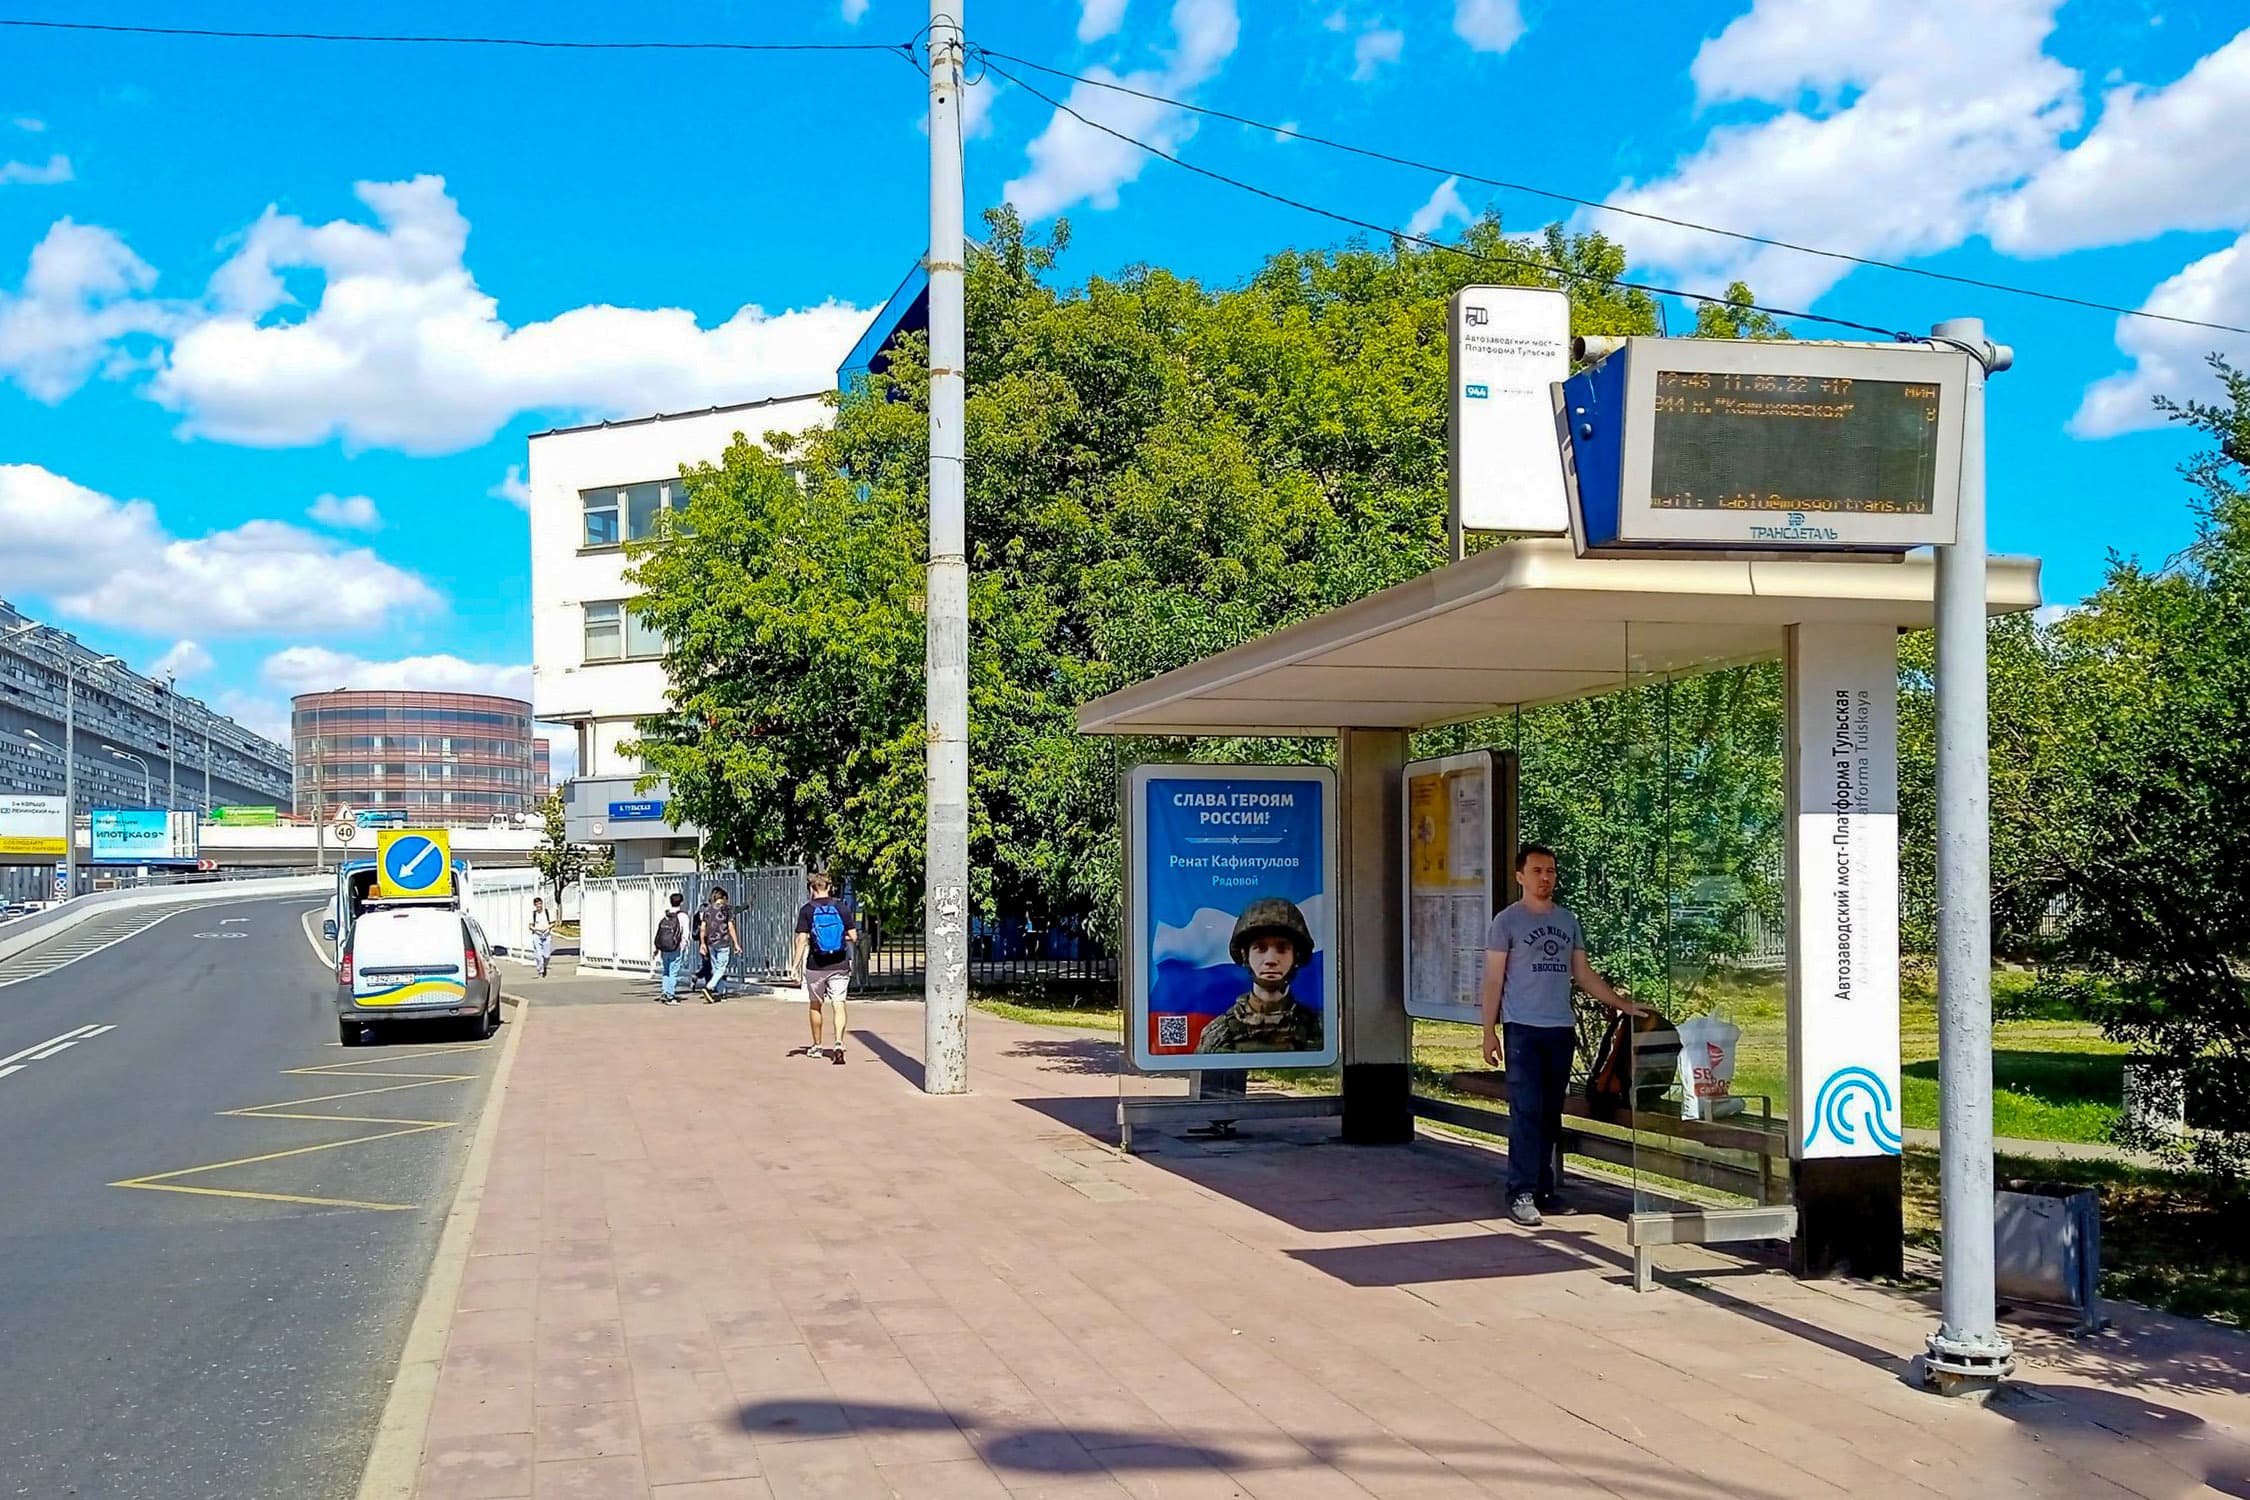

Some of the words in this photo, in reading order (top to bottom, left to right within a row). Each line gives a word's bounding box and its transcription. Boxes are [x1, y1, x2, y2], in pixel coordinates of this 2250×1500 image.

[1465, 344, 1515, 355] Платформа
[1518, 347, 1556, 358] Тульская
[1467, 386, 1487, 398] 944
[1749, 527, 1838, 540] ТРАНСДЕТАЛЬ
[1832, 689, 1854, 757] Тульская
[1854, 690, 1871, 753] Tulskaya
[1173, 793, 1228, 807] СЛАВА
[1230, 793, 1294, 807] ГЕРОЯМ
[1200, 811, 1271, 825] РОССИИ!
[338, 827, 352, 837] 40
[1169, 855, 1209, 868] Ренат
[1211, 855, 1300, 870] Кафиятуллов
[1212, 875, 1259, 887] Рядовой
[1523, 927, 1546, 946] LATE
[1547, 925, 1571, 944] NIGHT
[1833, 891, 1853, 1001] Автозаводский
